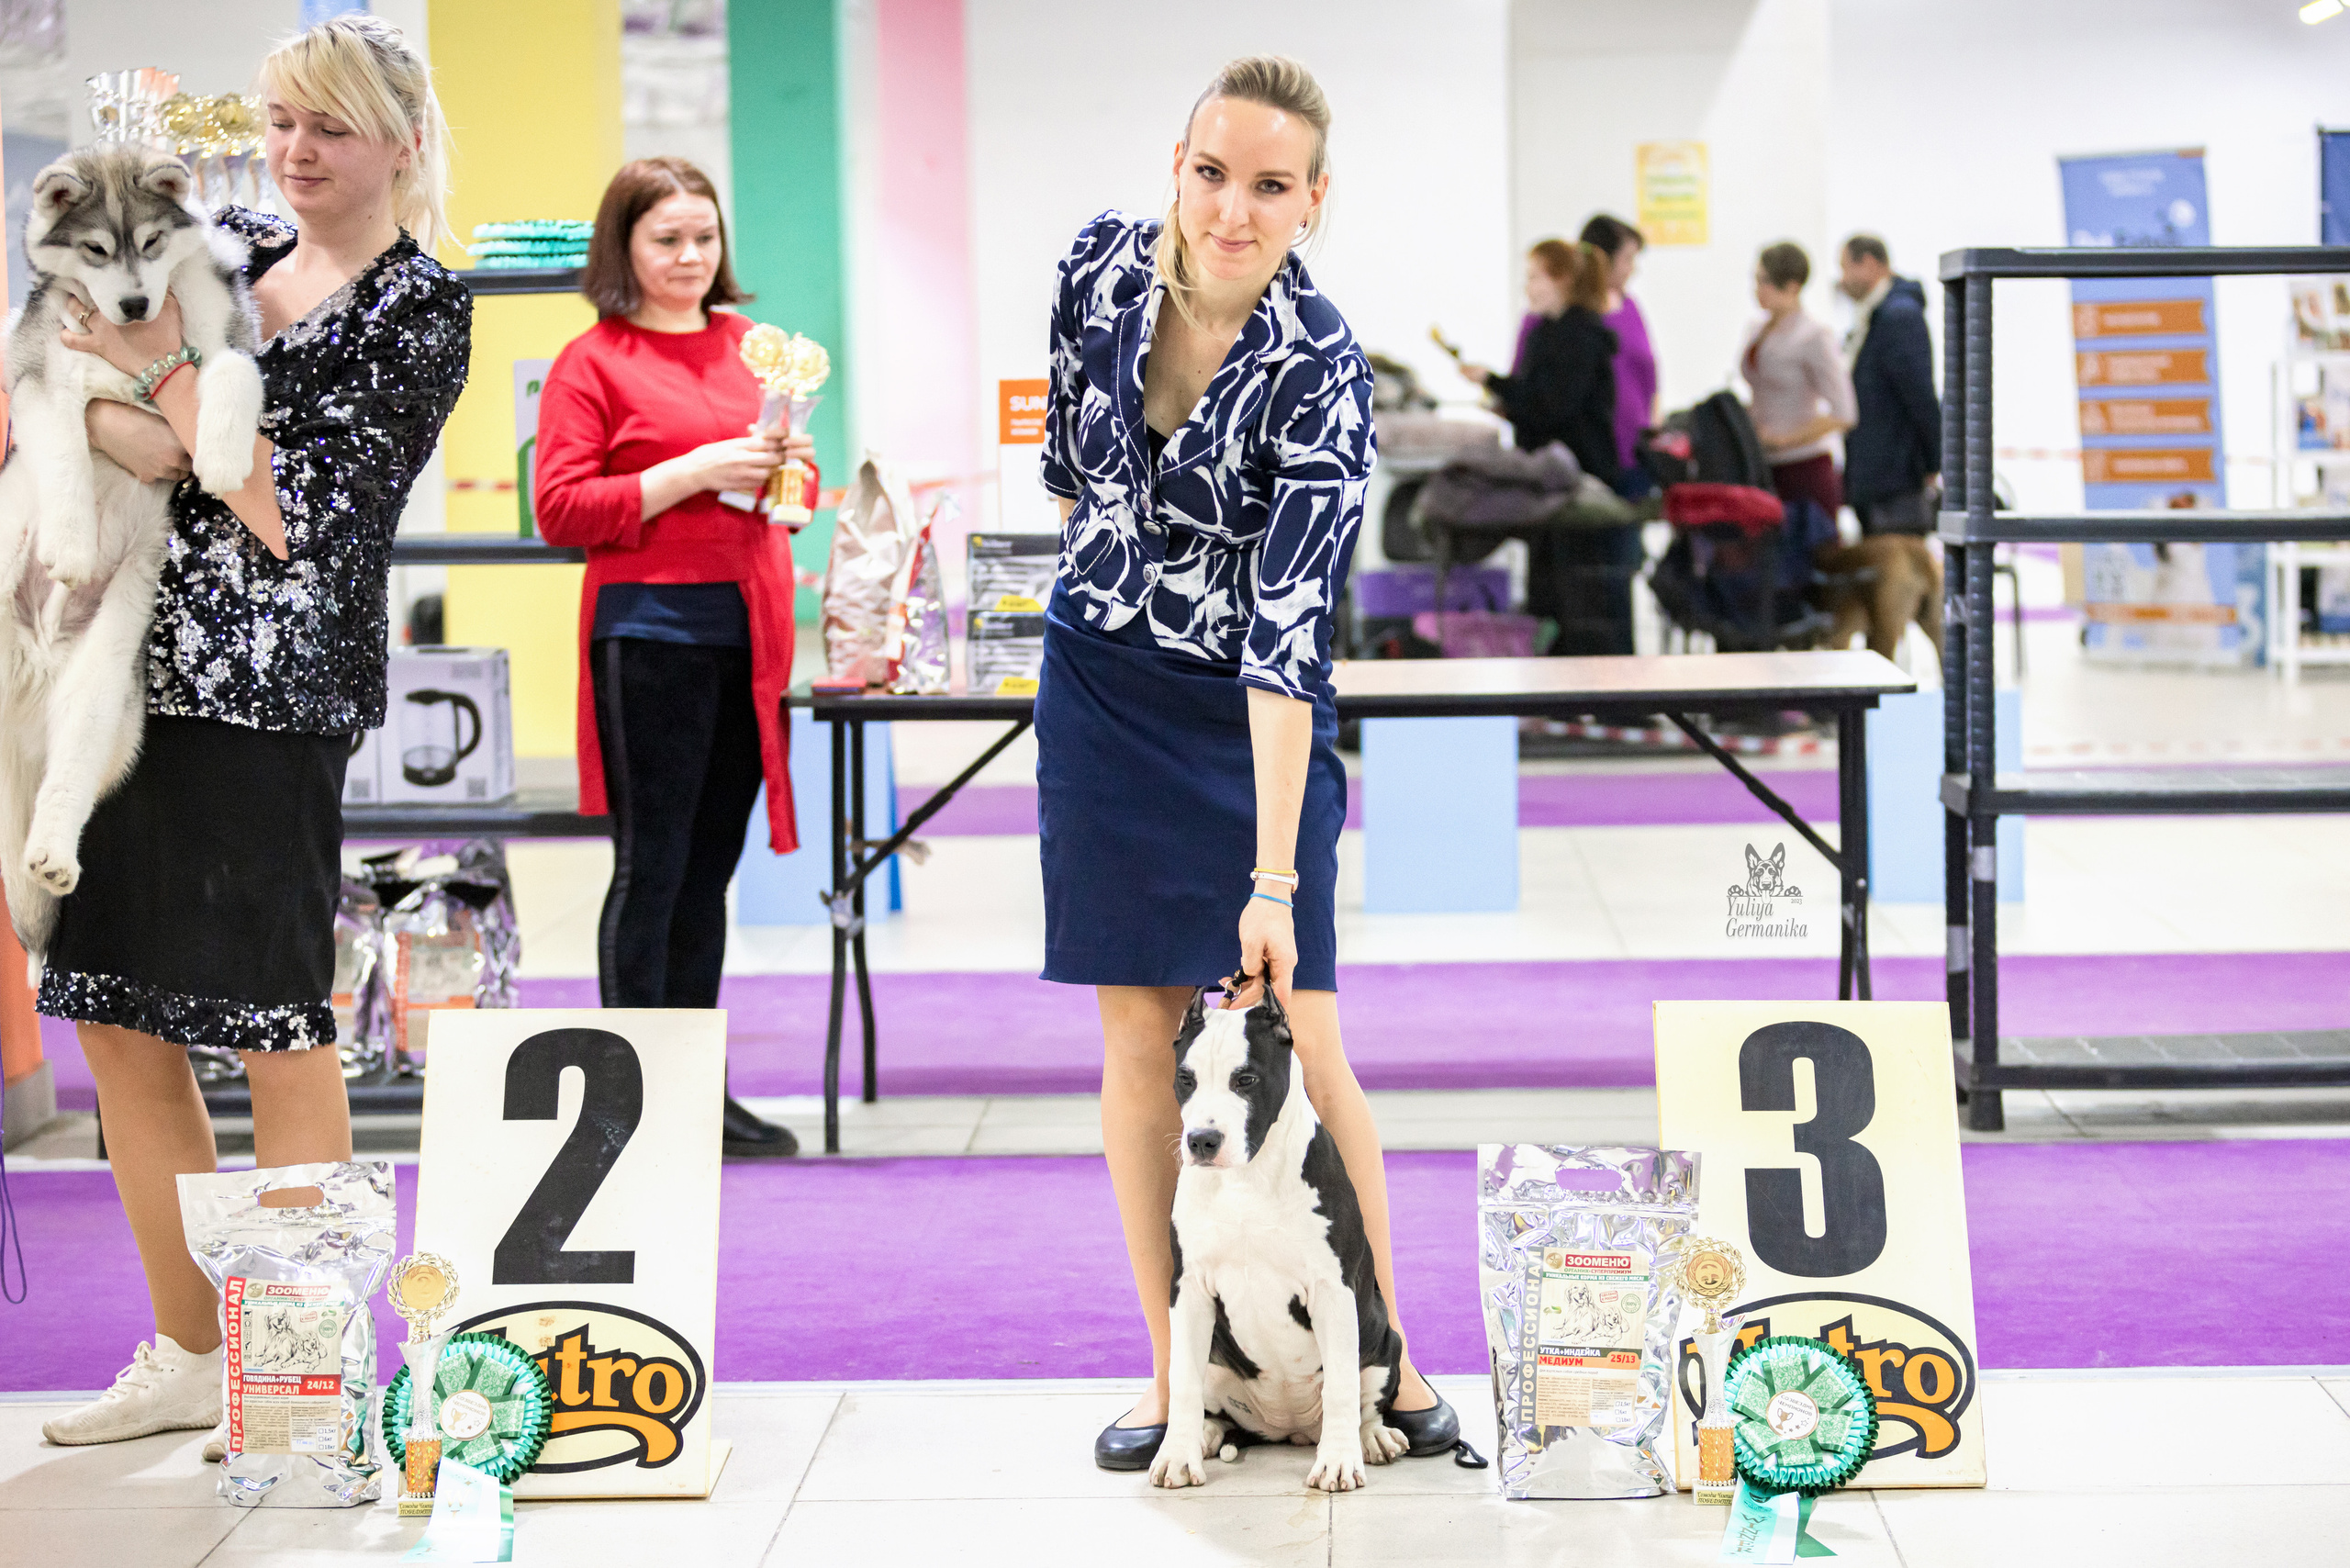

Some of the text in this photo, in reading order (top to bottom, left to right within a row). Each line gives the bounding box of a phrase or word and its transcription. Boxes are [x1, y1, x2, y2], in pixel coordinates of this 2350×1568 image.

[1740, 1022, 1887, 1277] 3
[493, 1028, 643, 1284] 2
[1567, 1256, 1629, 1267] ЗООМЕНЮ
[268, 1286, 330, 1295] ЗООМЕНЮ
[1521, 1250, 1541, 1422] ПРОФЕССИОНАЛ
[1539, 1356, 1583, 1366] МЕДИУМ
[1610, 1354, 1636, 1363] 25/13
[228, 1280, 243, 1449] ПРОФЕССИОНАЛ
[242, 1384, 299, 1394] УНИВЕРСАЛ
[307, 1381, 335, 1389] 24/12
